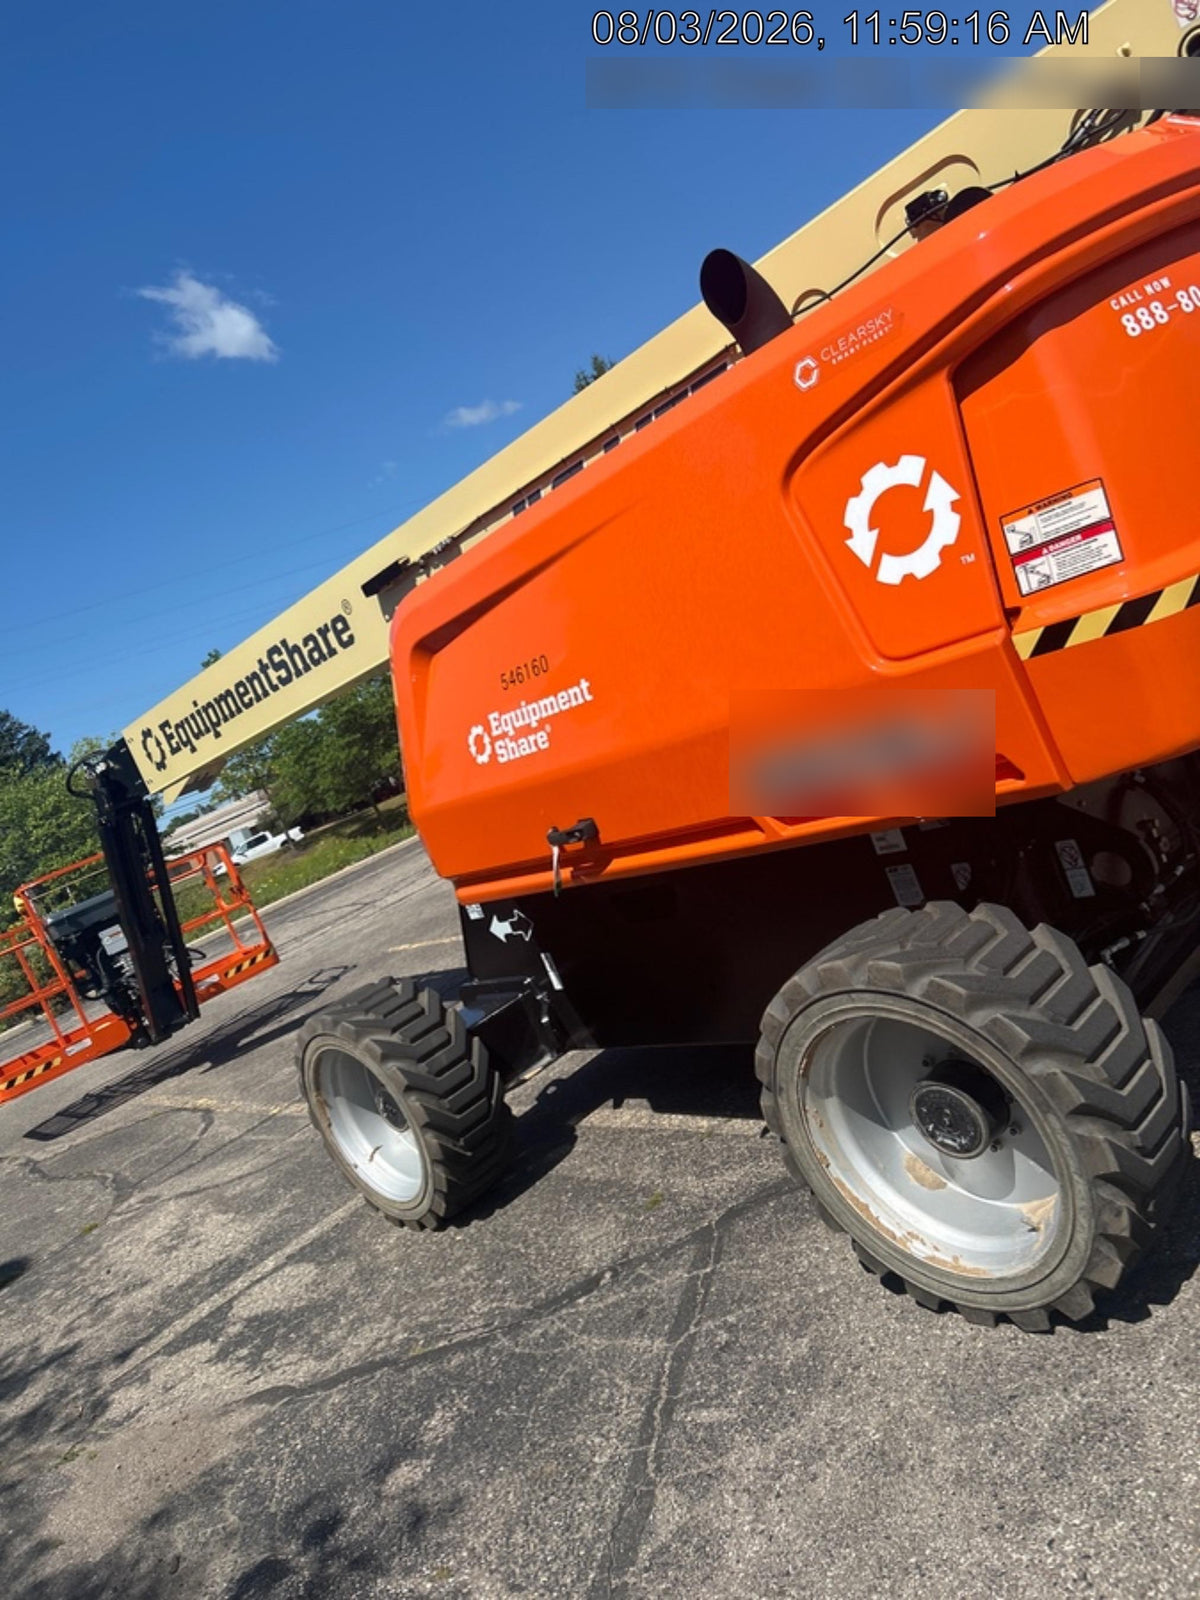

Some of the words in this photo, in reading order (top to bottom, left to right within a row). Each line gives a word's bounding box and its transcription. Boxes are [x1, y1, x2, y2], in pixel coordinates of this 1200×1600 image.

[1109, 289, 1143, 311] CALL
[1143, 276, 1171, 296] NOW
[820, 308, 893, 362] CLEARSKY
[499, 654, 549, 691] 546160
[487, 678, 593, 737] Equipment
